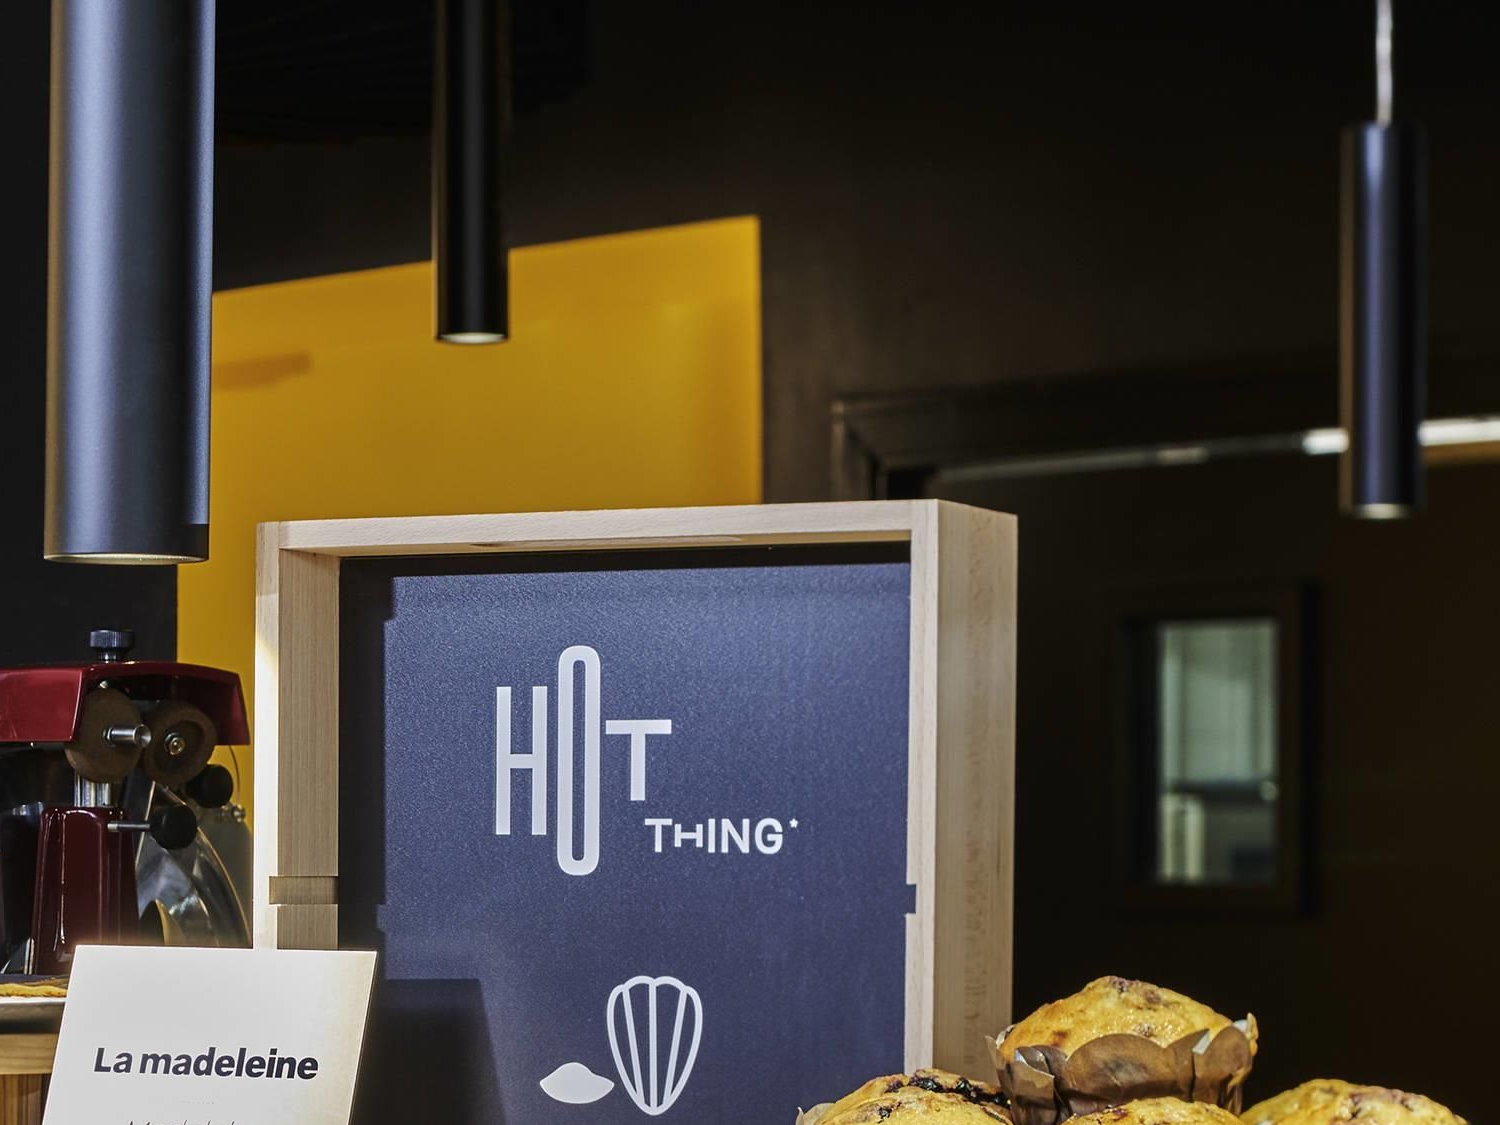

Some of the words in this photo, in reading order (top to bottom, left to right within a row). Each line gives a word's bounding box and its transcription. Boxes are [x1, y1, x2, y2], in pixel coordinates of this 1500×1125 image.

[495, 645, 672, 876] HOT
[94, 1047, 132, 1074] La
[138, 1046, 319, 1081] madeleine
